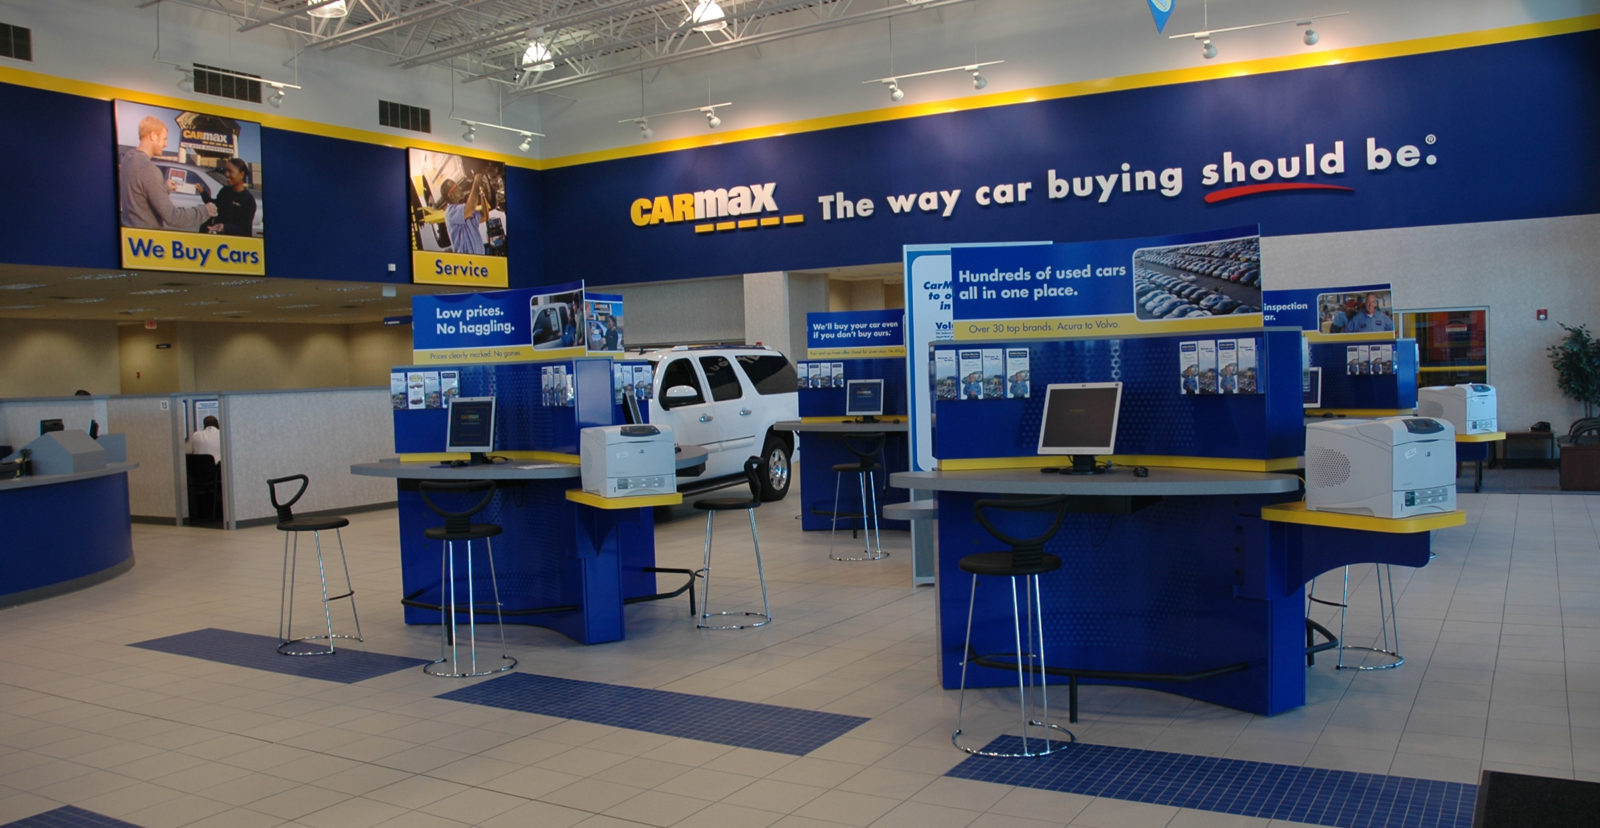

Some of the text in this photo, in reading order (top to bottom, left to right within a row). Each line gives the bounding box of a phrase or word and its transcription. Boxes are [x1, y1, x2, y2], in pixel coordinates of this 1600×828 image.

[818, 192, 875, 220] The
[886, 189, 961, 217] way
[975, 182, 1032, 206] car
[1048, 162, 1183, 203] buying
[1202, 141, 1345, 186] should
[630, 182, 779, 227] CARmax
[128, 237, 259, 267] We Buy Cars
[435, 259, 489, 277] Service
[959, 264, 1127, 283] Hundreds of used cars
[929, 292, 940, 300] to
[959, 283, 1078, 301] all in one place.
[436, 305, 504, 321] Low prices.
[940, 301, 951, 310] in
[1264, 302, 1308, 313] inspection
[436, 320, 515, 336] No haggling.
[813, 322, 832, 331] We'll
[834, 322, 848, 331] buy
[850, 323, 867, 331] your
[969, 324, 989, 334] Over
[993, 324, 1004, 333] 30
[1007, 325, 1020, 334] top
[1023, 321, 1053, 332] brands.
[1058, 322, 1082, 331] Acura
[1096, 319, 1120, 329] Volvo.
[813, 331, 819, 339] if
[820, 332, 834, 340] you
[837, 330, 856, 338] don't
[857, 330, 872, 339] buy
